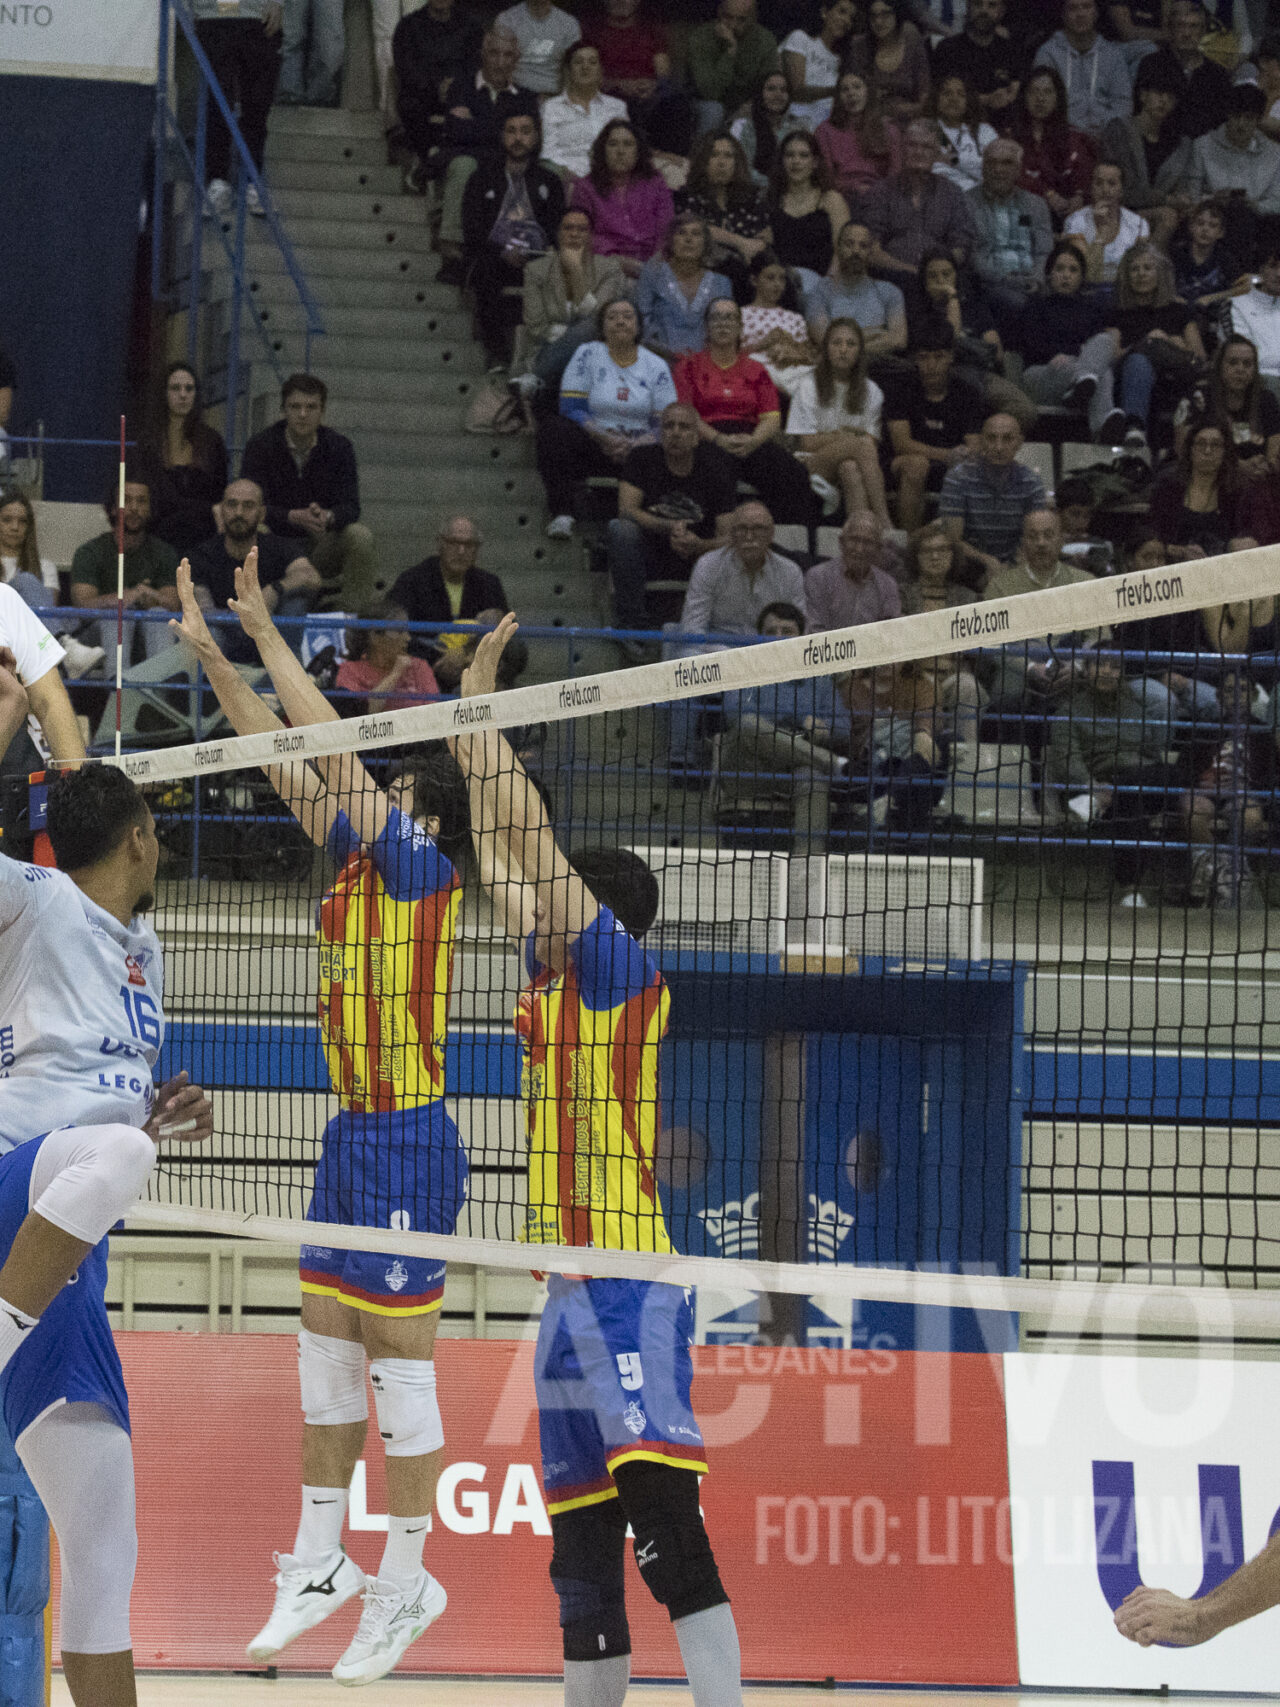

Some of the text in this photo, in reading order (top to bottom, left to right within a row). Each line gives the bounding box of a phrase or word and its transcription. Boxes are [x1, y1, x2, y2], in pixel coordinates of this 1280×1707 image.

[1116, 573, 1183, 609] rfevb.com
[950, 607, 1009, 640] rfevb.com
[803, 637, 857, 666] rfevb.com
[674, 660, 721, 688] rfevb.com
[559, 682, 601, 709] rfevb.com
[358, 716, 394, 741] rfevb.com
[453, 702, 492, 726] rfevb.com
[273, 733, 305, 754] rfevb.com
[120, 984, 160, 1051] 16
[616, 1352, 644, 1391] 9
[348, 1460, 553, 1535] LGA
[1092, 1460, 1280, 1649] U
